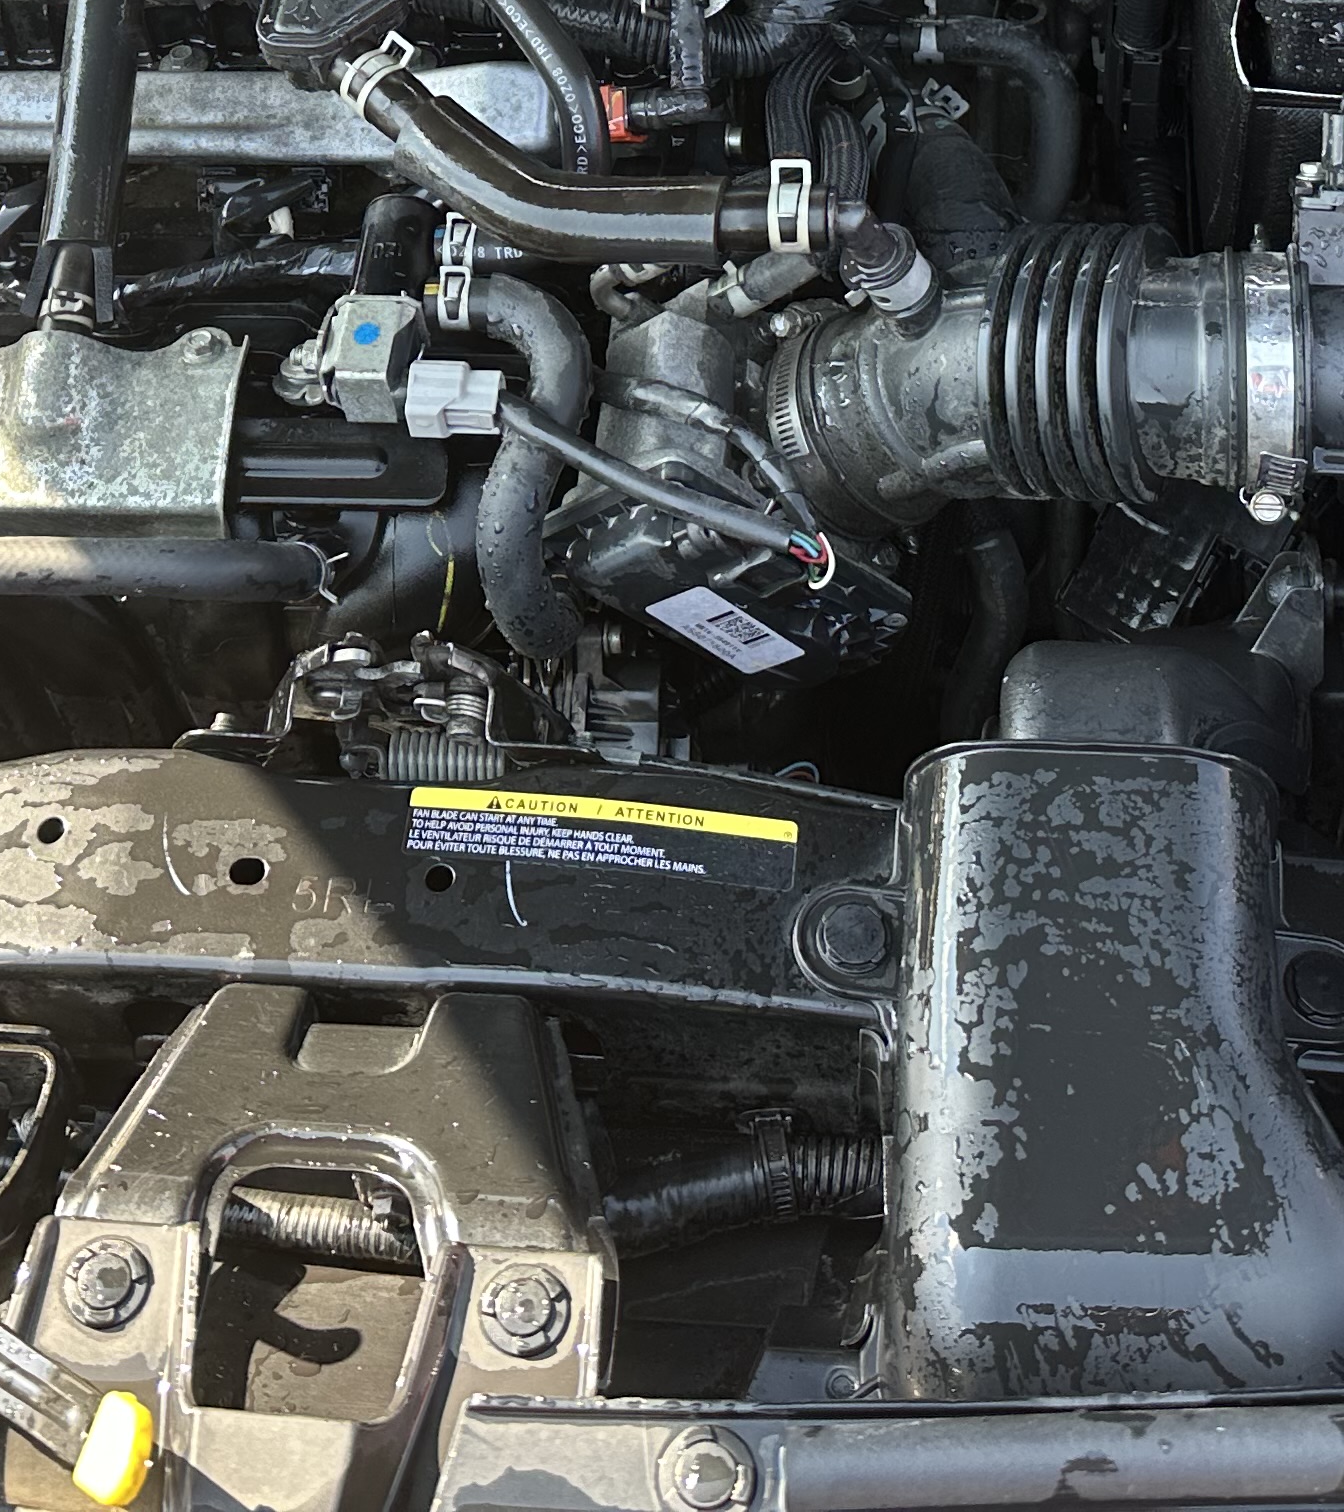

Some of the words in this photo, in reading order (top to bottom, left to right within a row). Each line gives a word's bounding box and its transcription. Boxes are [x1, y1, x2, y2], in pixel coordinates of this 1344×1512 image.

[413, 809, 430, 818] FAN
[431, 810, 458, 820] BLADE
[459, 812, 477, 821] CAN
[479, 813, 504, 823] START
[505, 814, 516, 824] AT
[516, 815, 535, 825] ANY
[537, 816, 559, 827] TIME.
[505, 798, 578, 813] CAUTION
[615, 806, 705, 827] ATTENTION
[408, 829, 420, 839] LE
[421, 830, 481, 843] VENTILATEUR
[483, 834, 516, 845] RISQUE
[518, 836, 531, 846] DE
[532, 836, 583, 850] DÉMARRER
[593, 842, 619, 853] TOUT
[620, 844, 665, 858] MOMENT.
[412, 819, 423, 828] TO
[424, 820, 446, 830] HELP
[446, 821, 474, 832] AVOID
[475, 823, 518, 834] PERSONAL
[520, 825, 550, 837] INJURY,
[551, 828, 572, 838] KEEP
[574, 830, 604, 841] HANDS
[605, 832, 634, 844] CLEAR.
[407, 839, 433, 850] POUR
[434, 840, 465, 852] ÉVITER
[466, 843, 498, 855] TOUTE
[499, 845, 546, 859] BLESSURE,
[547, 849, 561, 859] NE
[562, 849, 580, 861] PAS
[581, 852, 594, 862] EN
[595, 853, 652, 867] APPROCHER
[654, 858, 671, 870] LES
[672, 861, 707, 874] MAINS.
